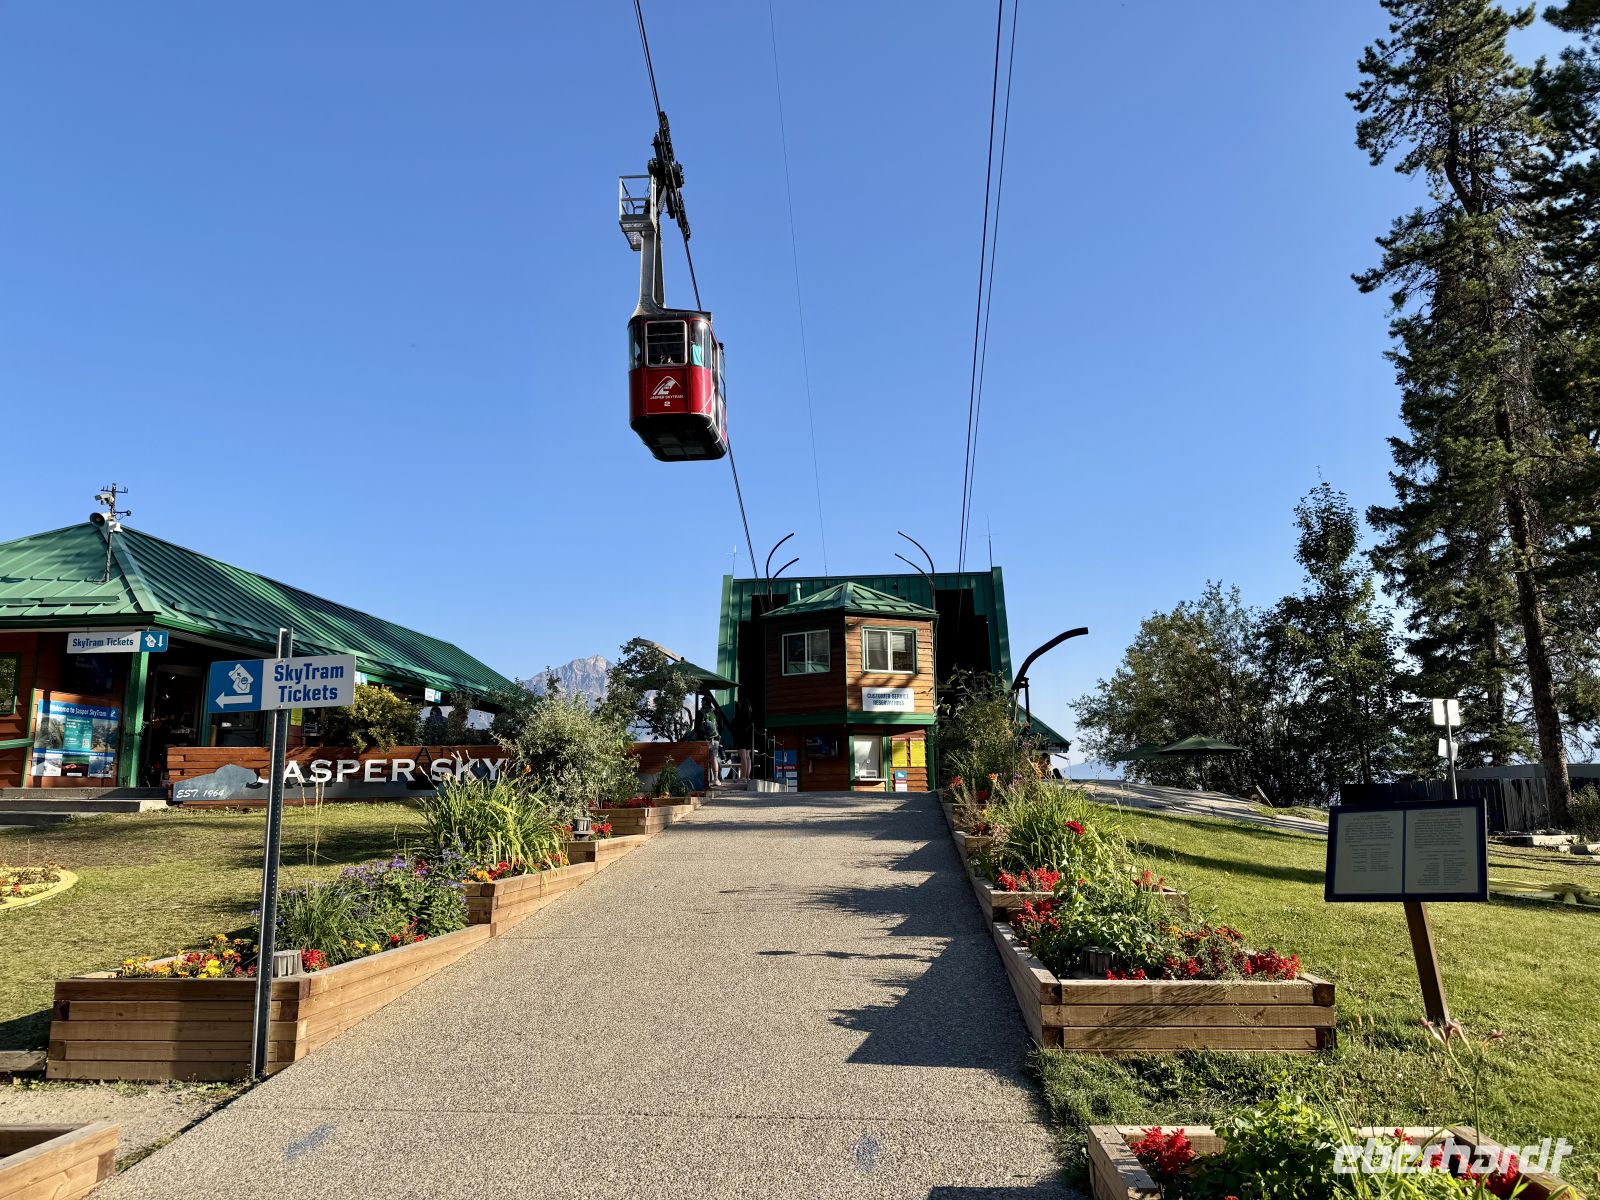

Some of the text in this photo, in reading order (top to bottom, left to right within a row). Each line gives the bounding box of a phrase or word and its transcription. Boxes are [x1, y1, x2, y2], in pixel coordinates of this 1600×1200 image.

[72, 637, 134, 649] SkyTram Tickets
[274, 662, 344, 684] SkyTram
[278, 685, 338, 702] Tickets
[257, 758, 417, 784] ASPER
[176, 788, 226, 799] EST. 1964
